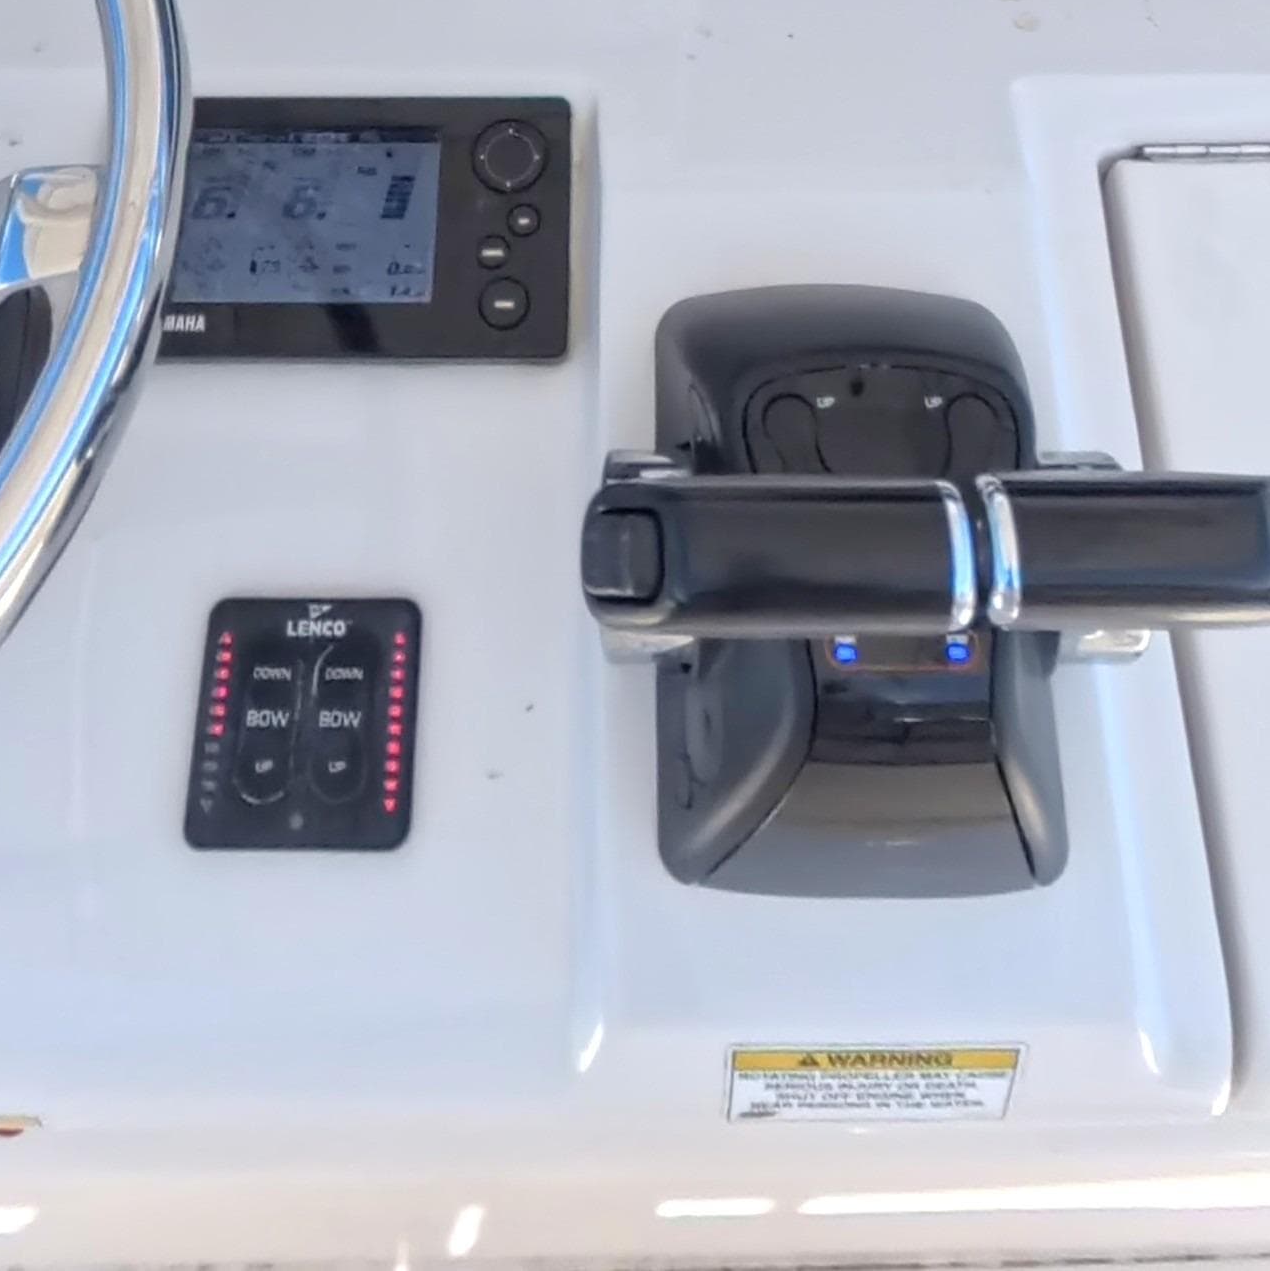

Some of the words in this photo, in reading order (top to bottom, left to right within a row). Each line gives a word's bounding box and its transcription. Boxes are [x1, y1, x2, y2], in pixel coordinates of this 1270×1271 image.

[162, 313, 206, 332] MAHA
[816, 396, 835, 409] UP
[924, 396, 943, 409] UP
[286, 619, 347, 638] LENCO
[253, 667, 292, 681] DOWN
[325, 667, 364, 681] DOWN
[246, 709, 290, 728] BOW
[319, 709, 362, 728] BOW
[255, 760, 274, 774] UP
[328, 760, 347, 774] UP
[826, 1052, 953, 1068] WARNING
